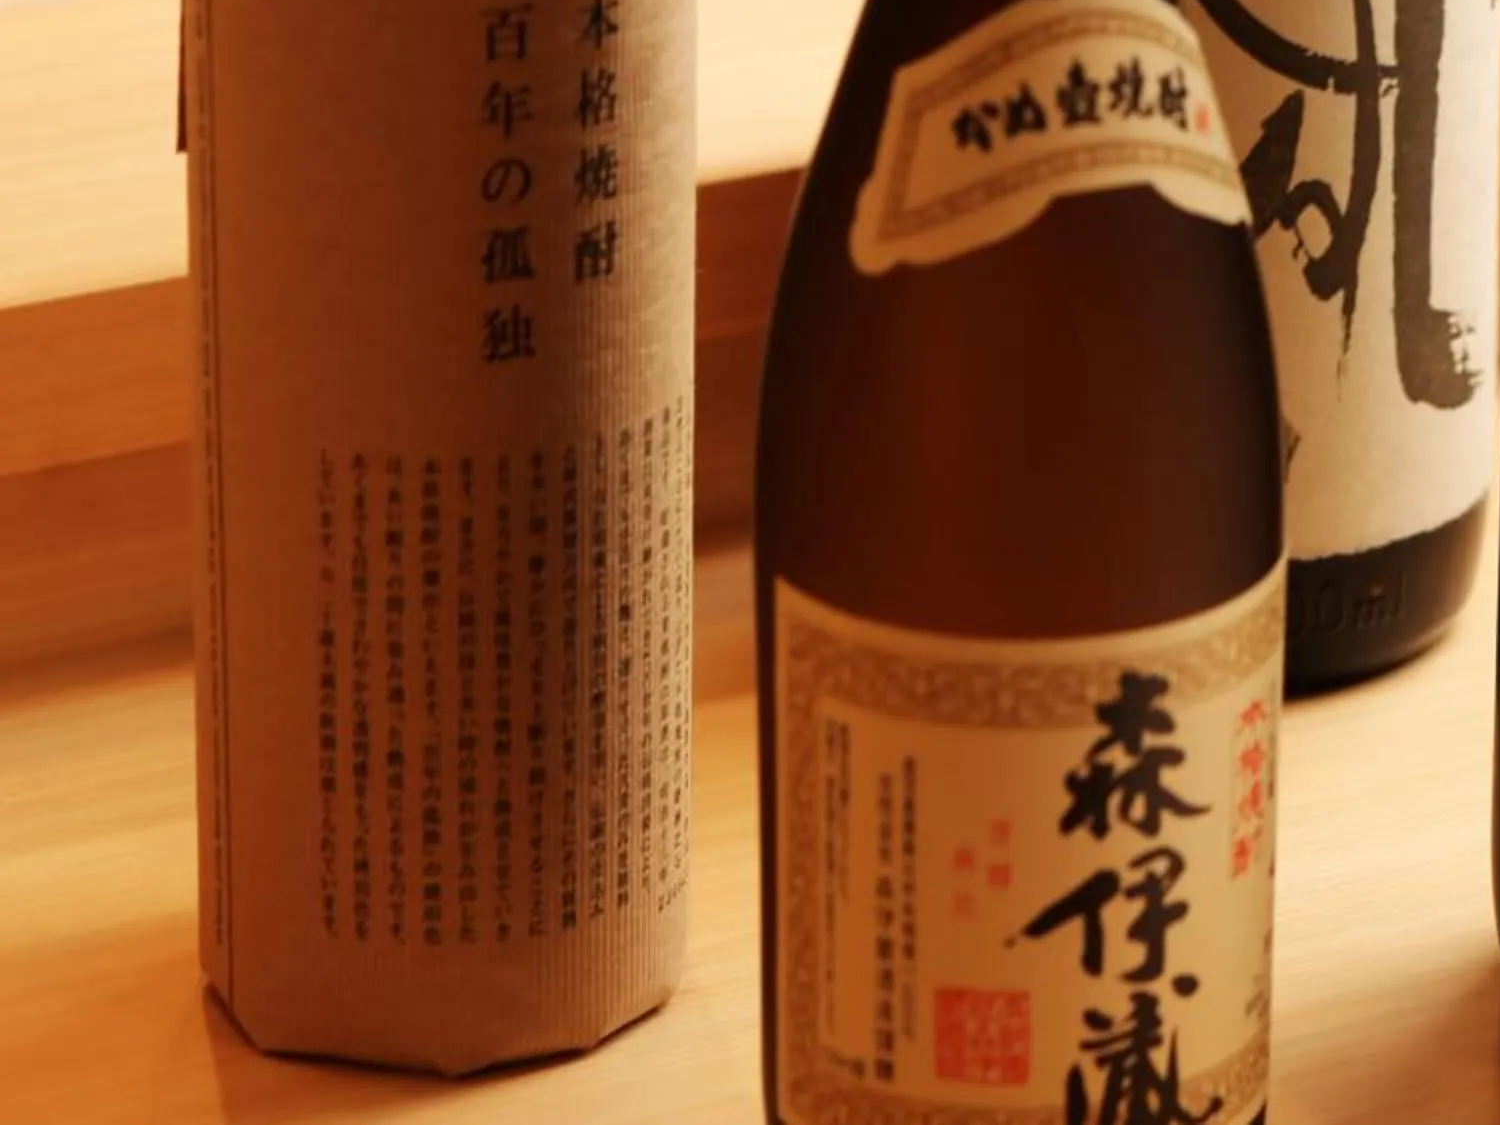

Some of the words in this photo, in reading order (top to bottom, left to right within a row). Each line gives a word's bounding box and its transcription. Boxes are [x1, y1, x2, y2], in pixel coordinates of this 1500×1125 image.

[481, 2, 536, 364] 百年の孤独
